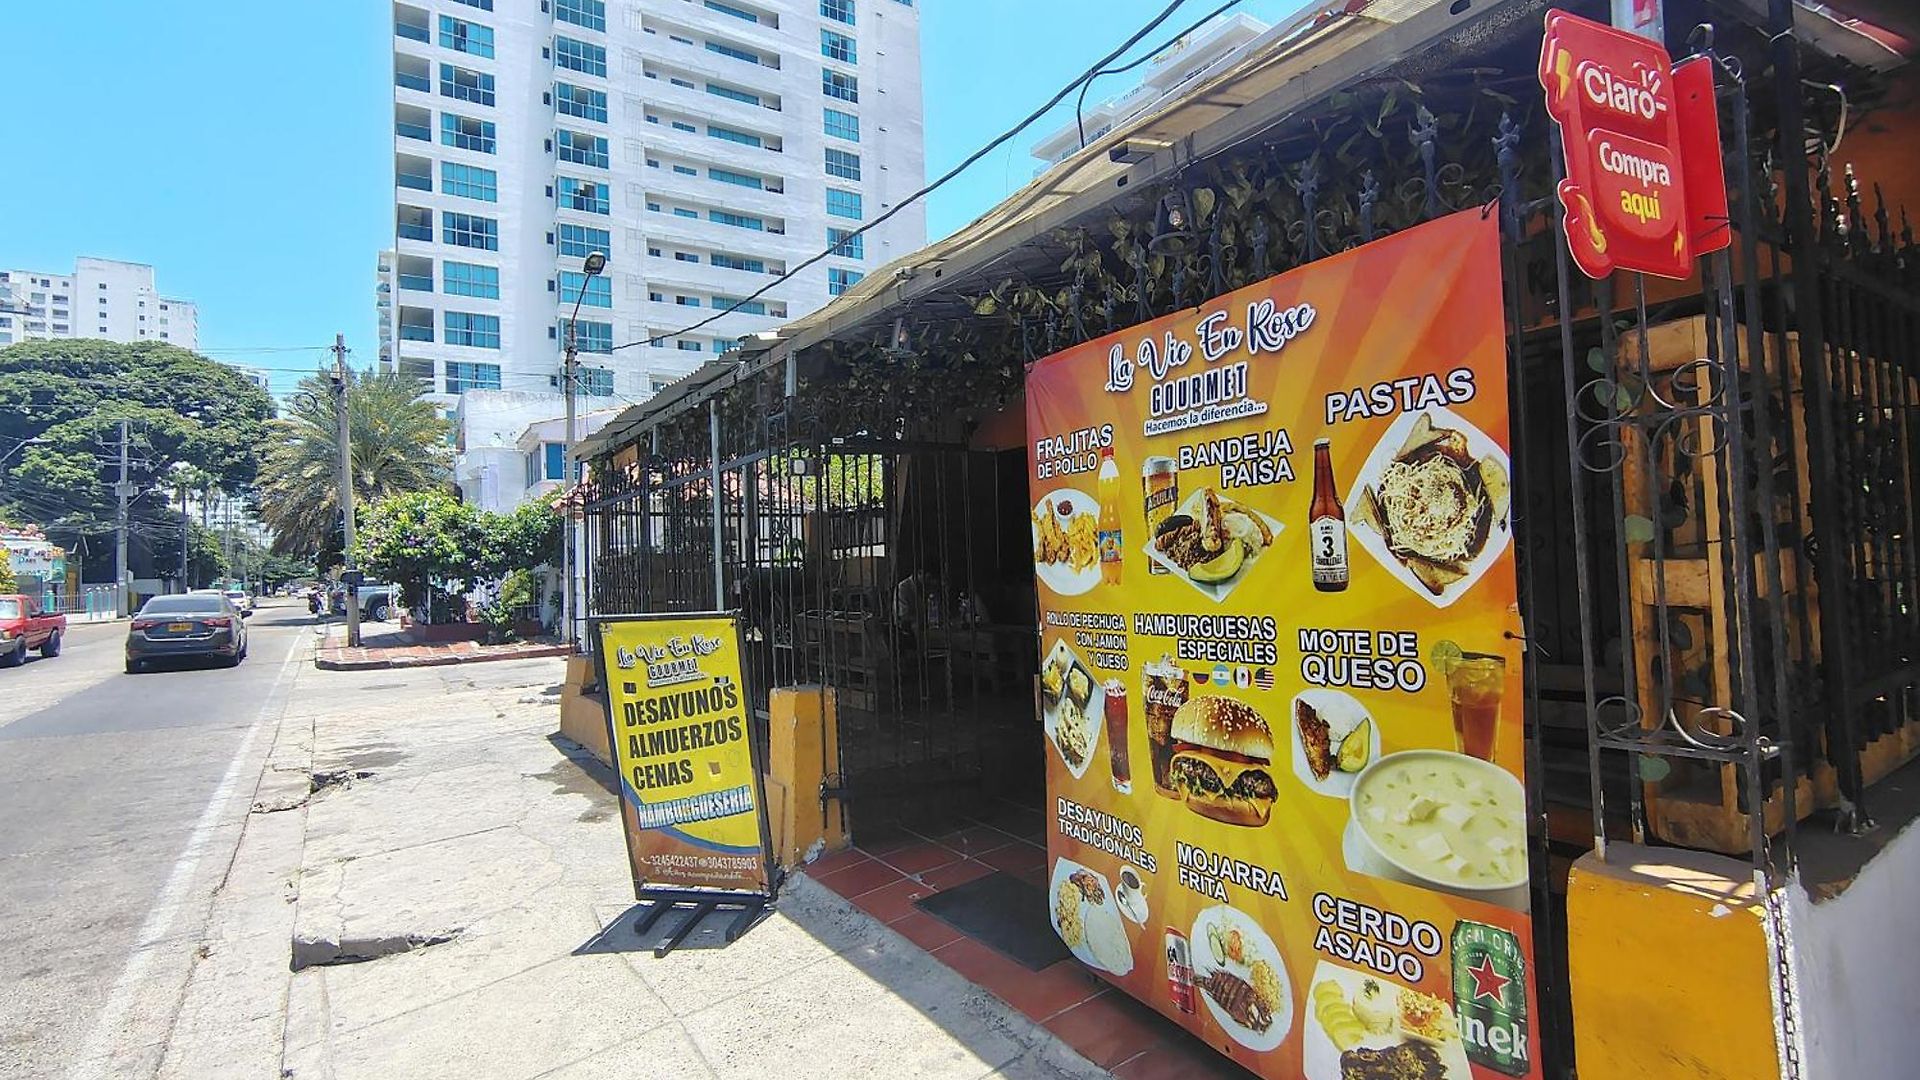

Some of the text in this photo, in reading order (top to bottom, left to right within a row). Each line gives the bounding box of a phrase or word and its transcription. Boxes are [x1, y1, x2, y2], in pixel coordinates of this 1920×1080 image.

[1584, 67, 1655, 119] Claro
[1600, 142, 1670, 188] Compra
[1620, 189, 1661, 224] aquí
[1105, 299, 1316, 391] La Vie En Rose
[1151, 363, 1247, 416] GOURMET
[1326, 367, 1475, 425] PASTAS
[1145, 401, 1265, 434] Hacemos la diferencia...
[1036, 425, 1114, 461] FRAJITAS
[1179, 429, 1293, 470] BANDEJA
[1037, 453, 1098, 480] DE POLLO
[1221, 456, 1295, 489] PAISA
[1322, 536, 1334, 557] 3
[1070, 612, 1081, 627] DE
[1082, 613, 1126, 630] PECHUGA
[1134, 613, 1276, 640] HAMBURGUESAS
[1075, 631, 1127, 650] CON JAMON
[1177, 639, 1277, 664] ESPECIALES
[1299, 629, 1418, 658] MOTE DE
[649, 658, 699, 679] GOURMET
[1087, 650, 1129, 671] Y QUESO
[1301, 654, 1426, 692] QUESO
[623, 683, 738, 727] DESAYUNOS
[629, 715, 742, 759] ALMUERZOS
[633, 759, 693, 790] CENAS
[638, 785, 754, 830] HAMBURGUESERIA
[1057, 797, 1143, 847] DESAYUNOS
[1058, 817, 1157, 874] TRADICIONALES
[1176, 841, 1288, 901] MOJARRA
[1178, 865, 1229, 903] FRITA
[1312, 892, 1442, 956] CERDO
[1314, 926, 1424, 982] ASADO
